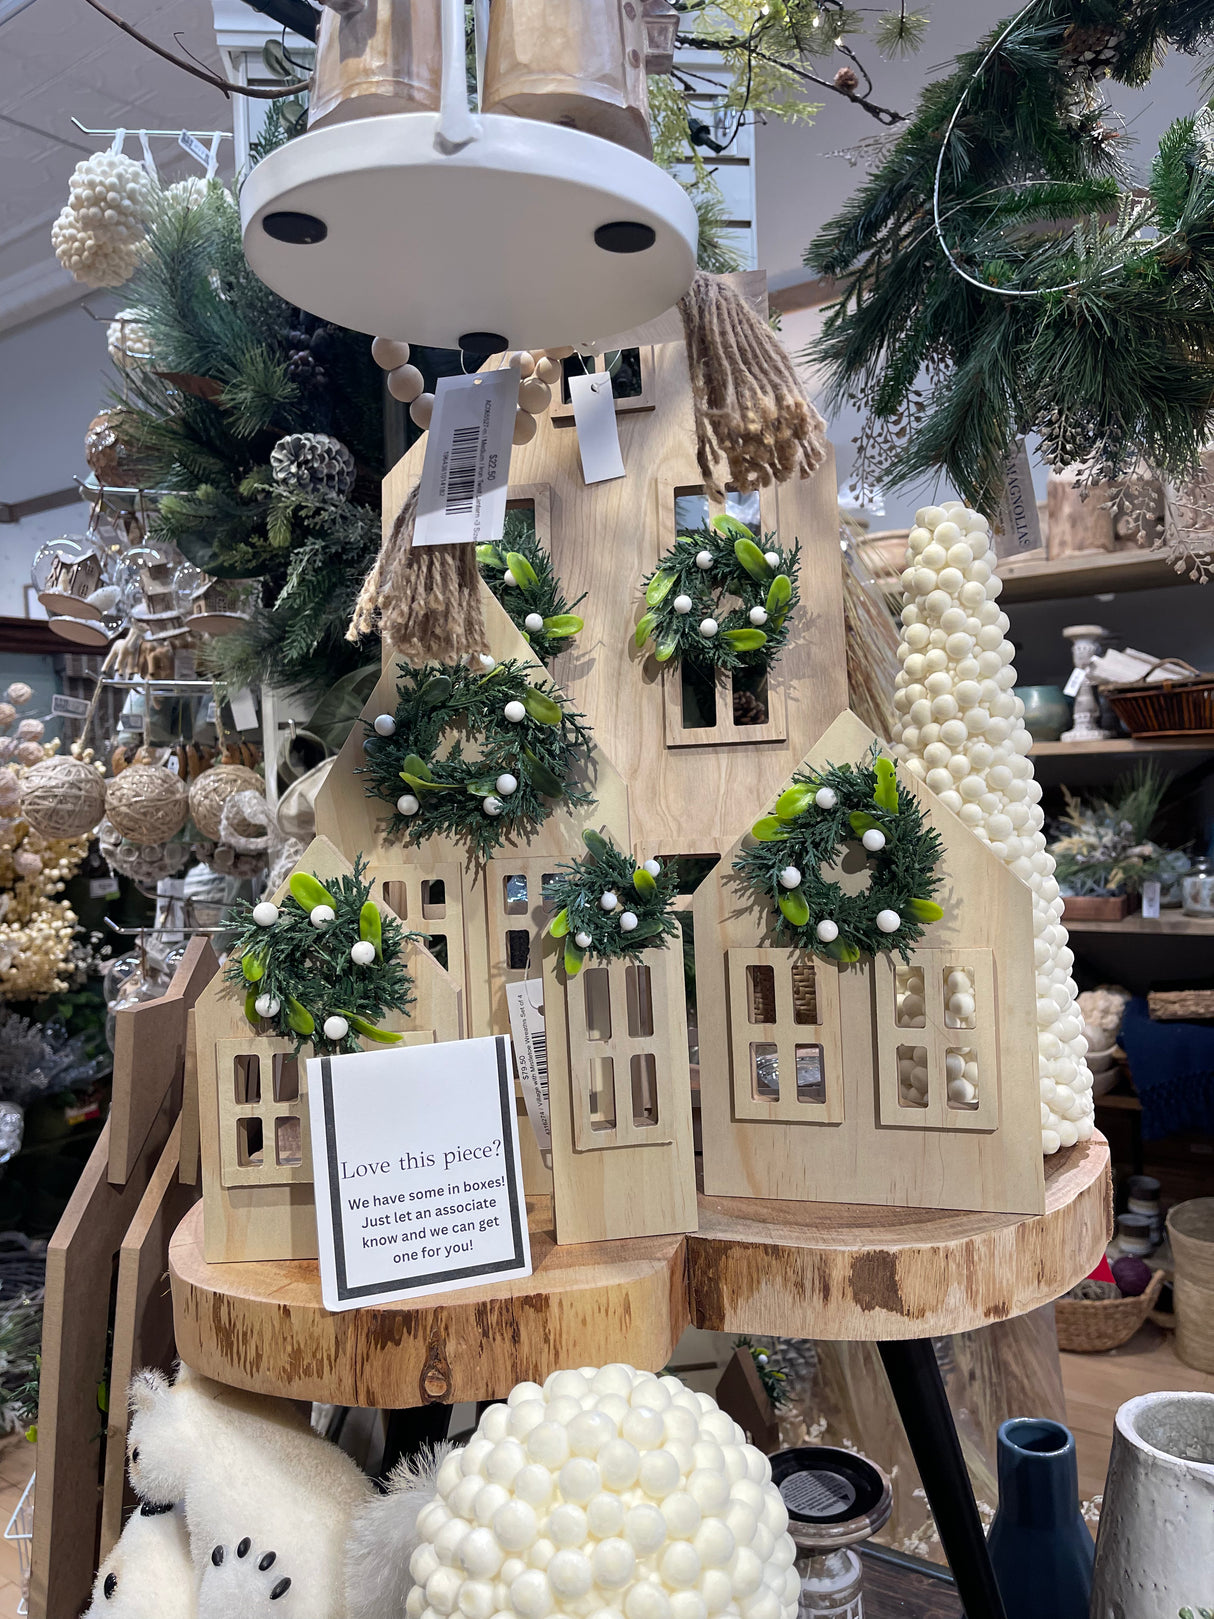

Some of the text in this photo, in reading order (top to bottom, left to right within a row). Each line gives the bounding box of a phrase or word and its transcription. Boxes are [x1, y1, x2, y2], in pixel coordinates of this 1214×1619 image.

[480, 439, 488, 461] Medium
[487, 454, 498, 481] $22.50
[476, 479, 484, 494] Twist
[522, 1018, 530, 1044] Wreaths
[519, 1055, 529, 1081] $79.50
[526, 1045, 536, 1073] Mistletoe
[535, 1088, 543, 1107] Village
[341, 1139, 501, 1180] Love this piece?
[348, 1176, 506, 1210] We have some in boxes!
[361, 1198, 497, 1229] Just let an associate
[362, 1216, 500, 1249] know and we can get
[393, 1239, 474, 1264] one for you!
